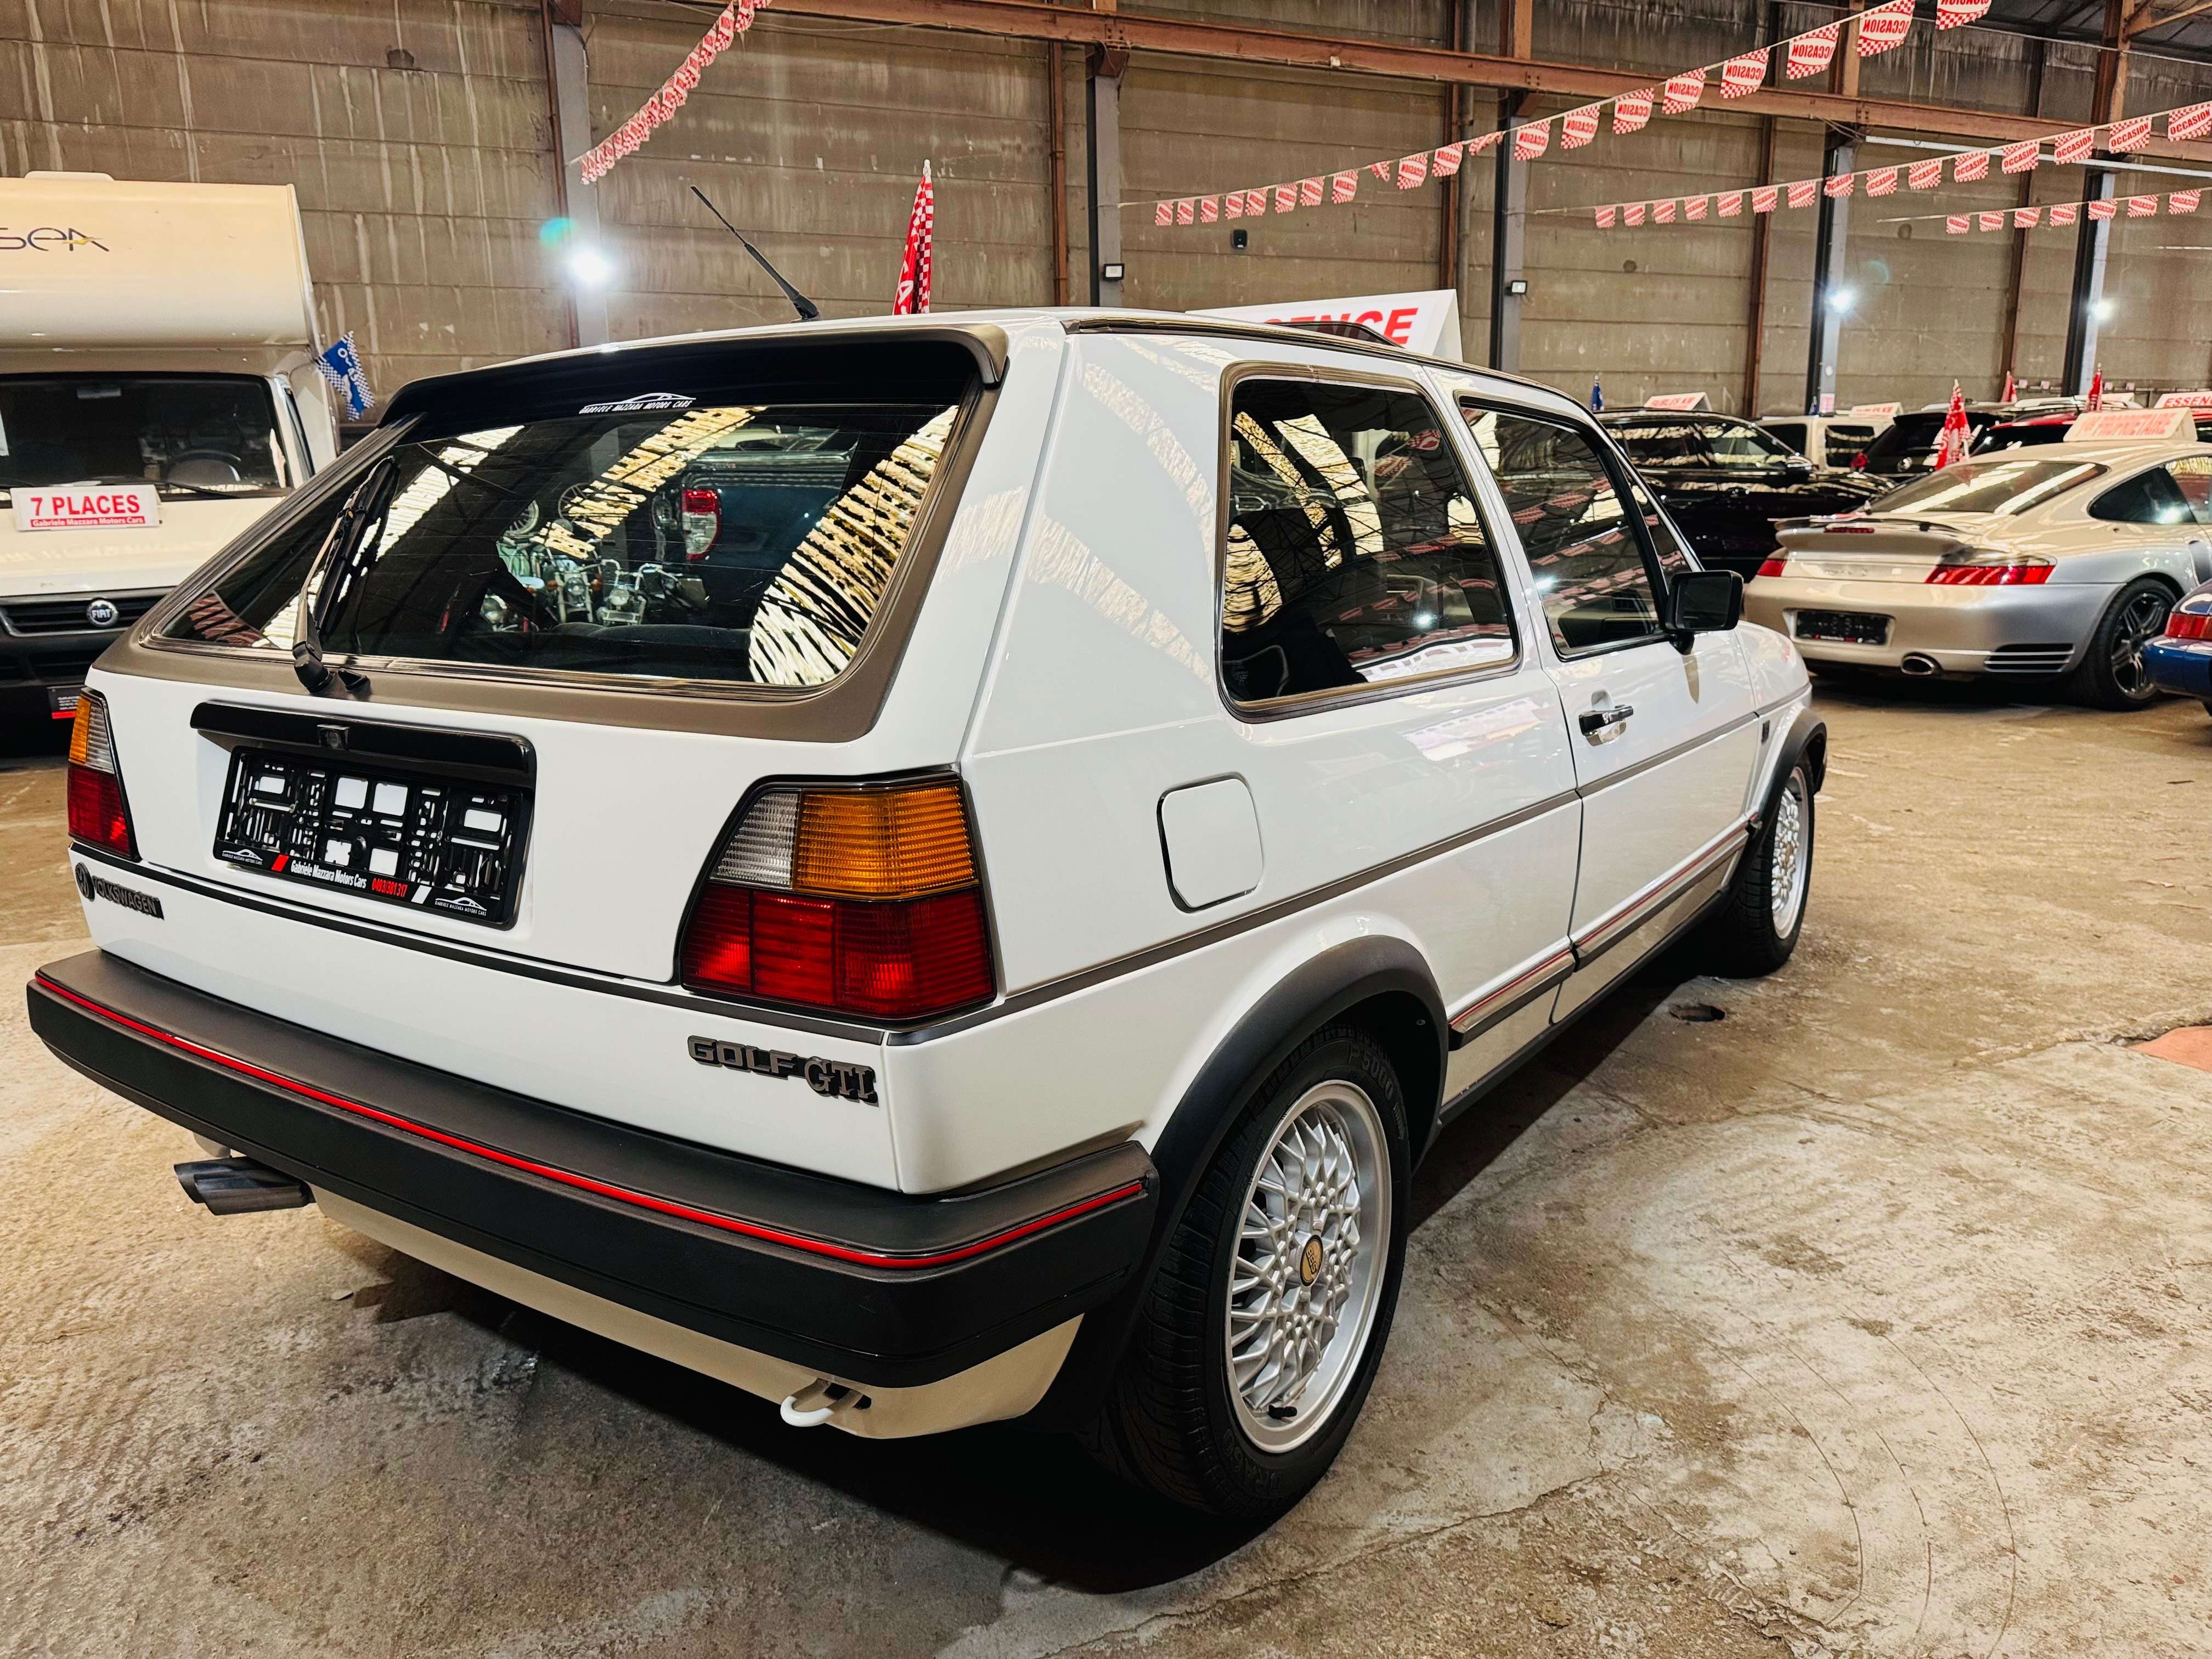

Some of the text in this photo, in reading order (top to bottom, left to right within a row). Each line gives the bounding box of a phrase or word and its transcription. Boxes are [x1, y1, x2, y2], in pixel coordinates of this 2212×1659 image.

[2170, 109, 2211, 134] OCCASION
[2056, 134, 2092, 158] OCCASION
[2111, 122, 2149, 146] OCCASION
[2004, 145, 2037, 167] OCCASION
[2164, 396, 2212, 408] ESSEN
[30, 494, 140, 516] 7 PLACES
[92, 608, 110, 619] FIAT
[291, 860, 313, 877] Gabriele
[312, 864, 335, 882] Mazzara
[334, 869, 354, 886] Motors
[353, 873, 367, 889] Cars
[687, 1035, 879, 1107] GOLF GTI
[1306, 1246, 1318, 1275] BBS
